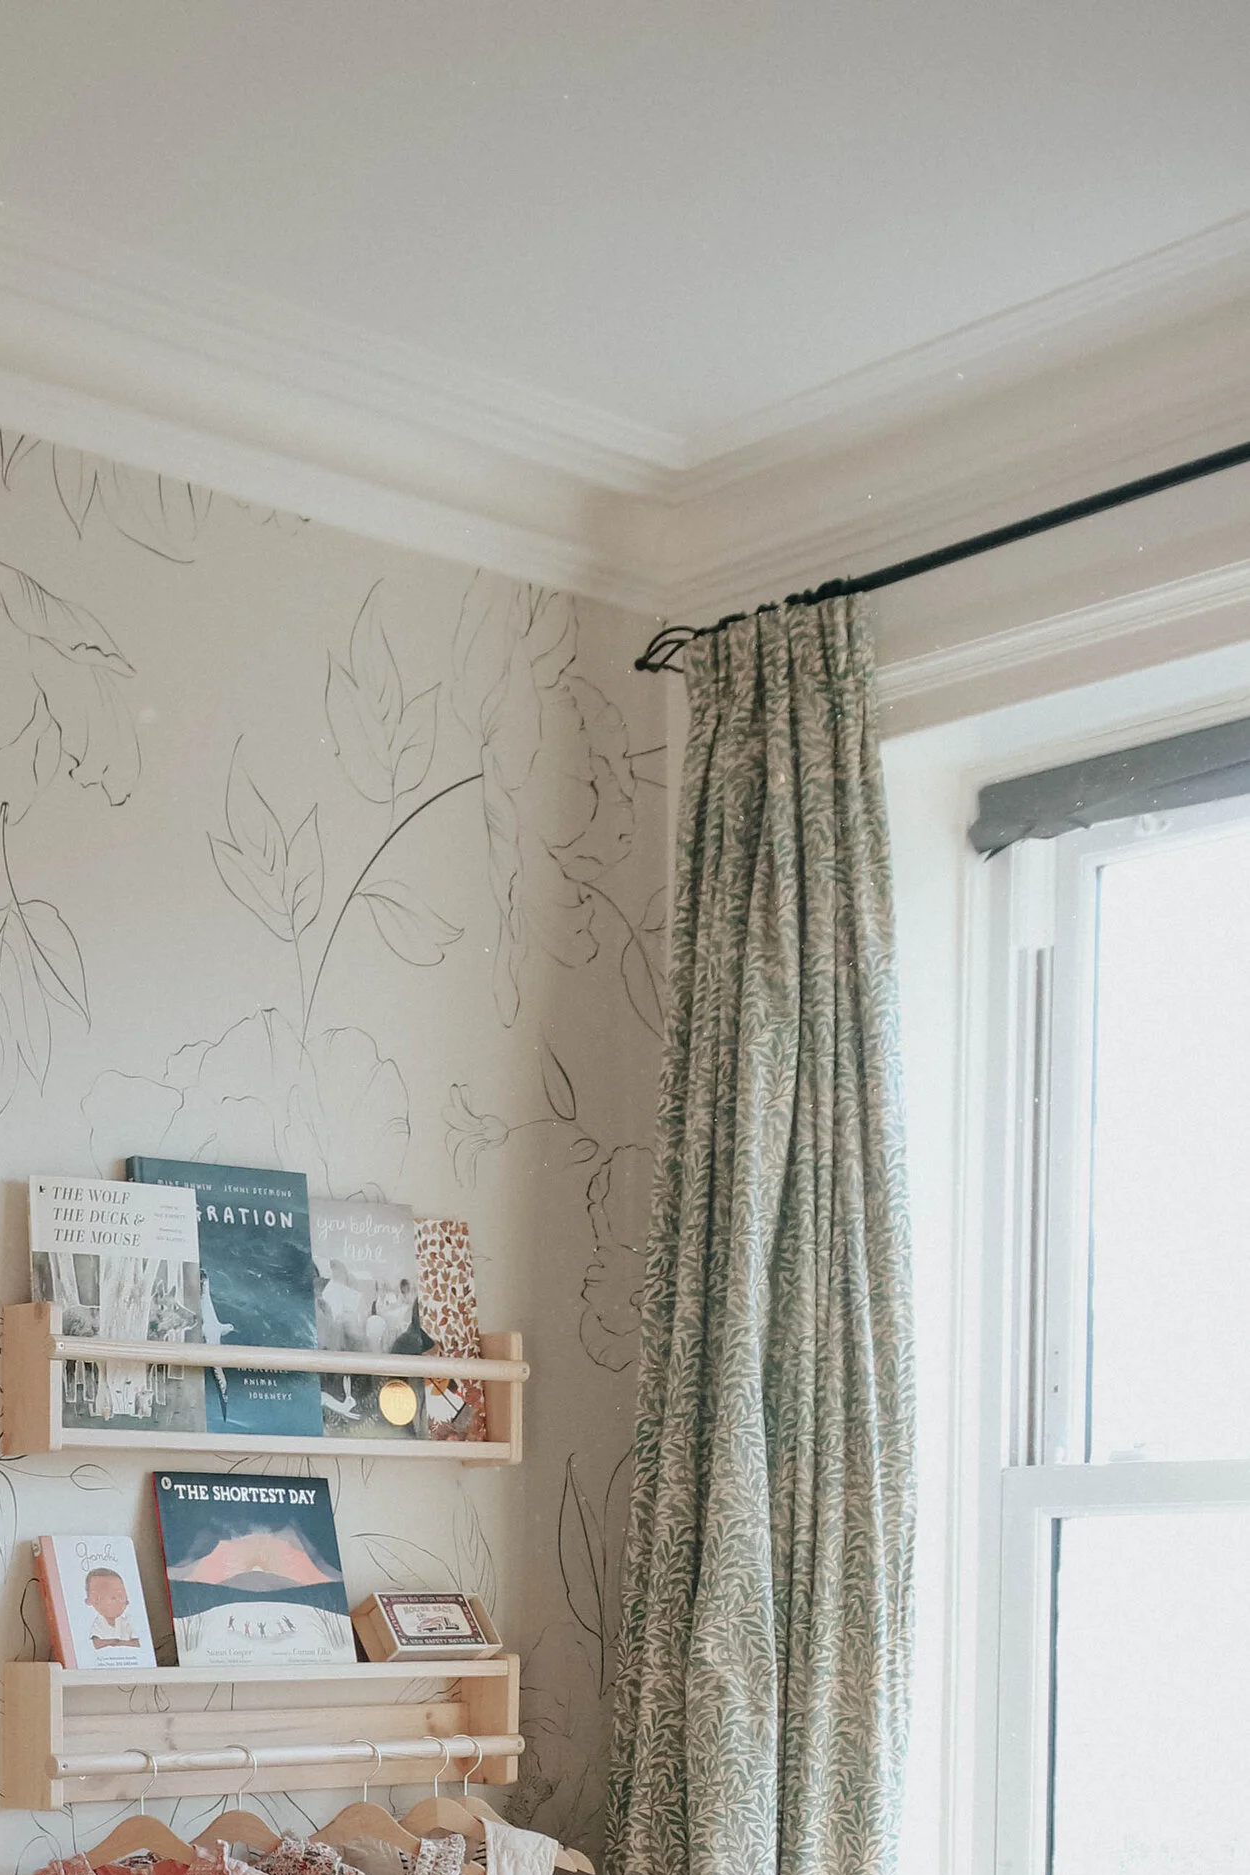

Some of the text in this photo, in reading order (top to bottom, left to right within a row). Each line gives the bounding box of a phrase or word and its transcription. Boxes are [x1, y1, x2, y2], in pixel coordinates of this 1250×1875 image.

[52, 1185, 131, 1205] THE WOLF
[53, 1207, 85, 1223] THE
[89, 1210, 130, 1226] DUCK
[133, 1213, 146, 1226] &
[196, 1203, 294, 1229] RATION
[53, 1228, 86, 1244] THE
[90, 1230, 142, 1247] MOUSE
[316, 1214, 405, 1245] you belong
[343, 1236, 385, 1261] here
[243, 1378, 278, 1388] ANIMAL
[248, 1391, 292, 1401] JOURNEYS
[173, 1484, 317, 1505] THE SHORTEST DAY
